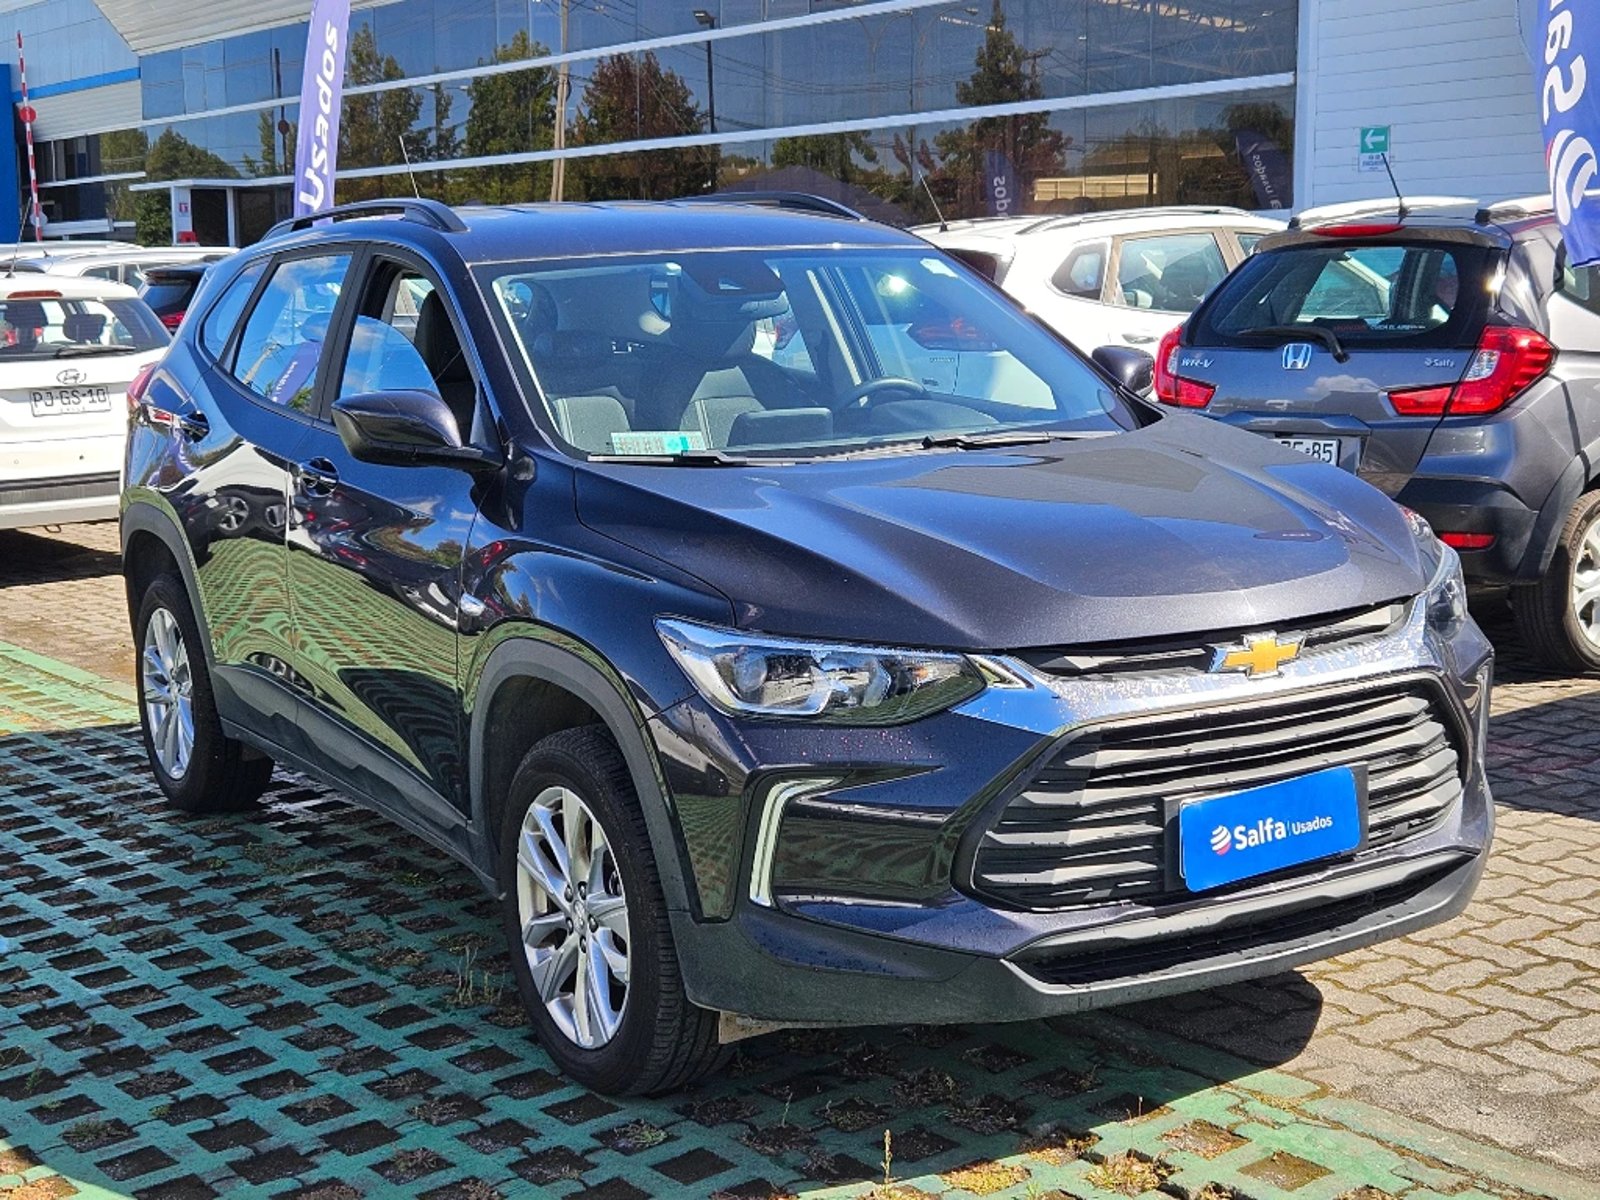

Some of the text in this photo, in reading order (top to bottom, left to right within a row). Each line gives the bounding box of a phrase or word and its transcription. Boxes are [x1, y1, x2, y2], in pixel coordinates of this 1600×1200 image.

[300, 20, 338, 212] Usados
[1181, 358, 1215, 368] WR-V
[1233, 815, 1333, 850] Salfa Usados
